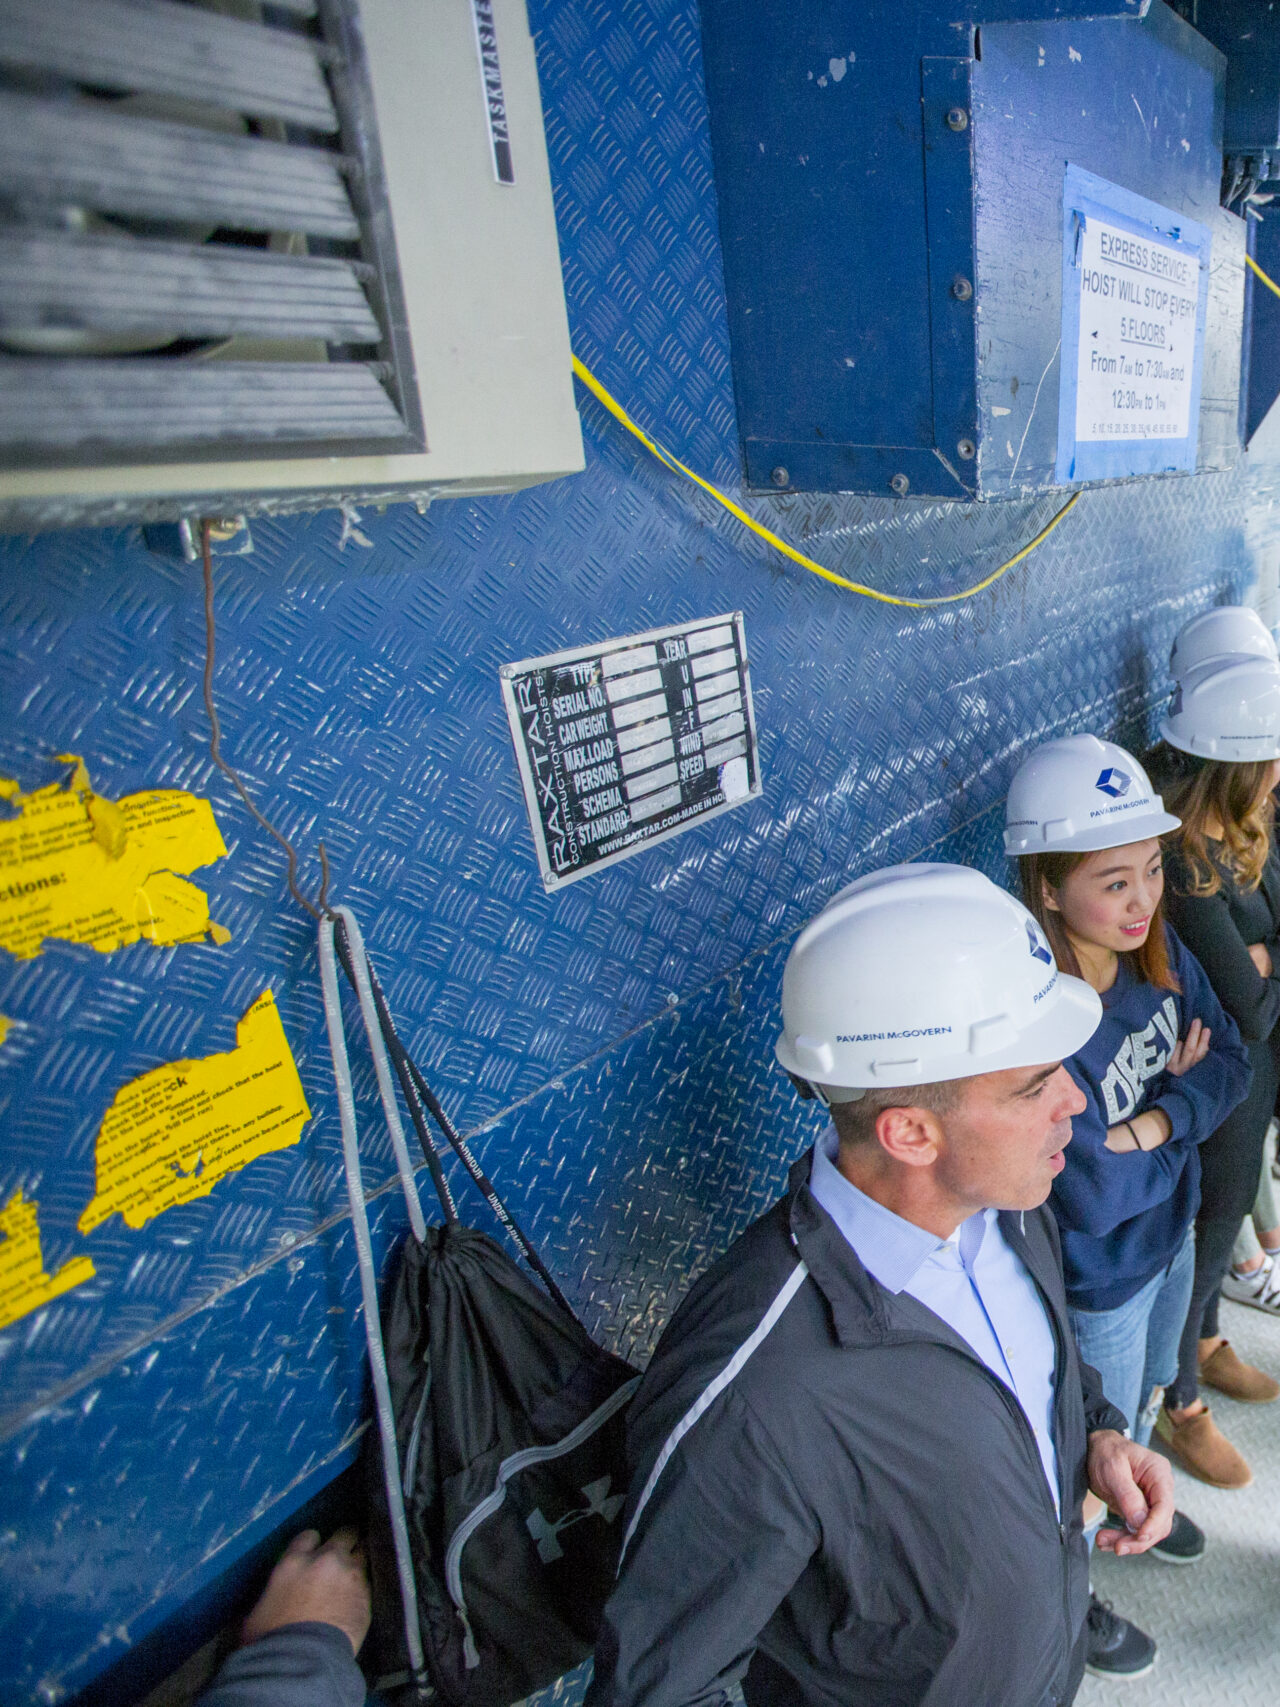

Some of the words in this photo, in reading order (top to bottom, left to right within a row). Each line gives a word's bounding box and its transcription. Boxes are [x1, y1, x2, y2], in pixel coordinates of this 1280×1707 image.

[1101, 232, 1148, 268] EXPRESS
[1151, 251, 1188, 281] SERVICE
[1083, 269, 1117, 297] HOIST
[1119, 279, 1142, 305] WILL
[1145, 287, 1169, 311] STOP
[1170, 295, 1197, 317] EVERY
[1121, 317, 1127, 336] 5
[1129, 319, 1165, 345] FLOORS
[1091, 350, 1116, 373] From
[1135, 359, 1144, 377] to
[1170, 364, 1185, 381] and
[1145, 393, 1154, 410] to
[664, 640, 687, 662] YEAR
[681, 665, 690, 684] U
[535, 675, 555, 737] HOISTS
[552, 691, 590, 720] SERIAL
[587, 687, 607, 709] NO.
[683, 687, 693, 708] IN
[559, 720, 578, 746] CAR
[577, 712, 609, 742] WEIGHT
[688, 712, 696, 731] F
[563, 738, 615, 772] MAX.LOAD
[679, 732, 702, 756] WIND
[519, 678, 572, 872] RAXTAR
[573, 761, 619, 795] PERSONS
[680, 754, 705, 780] SPEED
[548, 741, 580, 865] CONSTRUCTION
[582, 787, 623, 818] SCHEMA
[703, 798, 713, 812] IN
[836, 1032, 886, 1044] PAVARINI
[887, 1026, 952, 1039] McGOVERN
[458, 1140, 485, 1180] ARMOUR
[487, 1192, 509, 1223] UNDER
